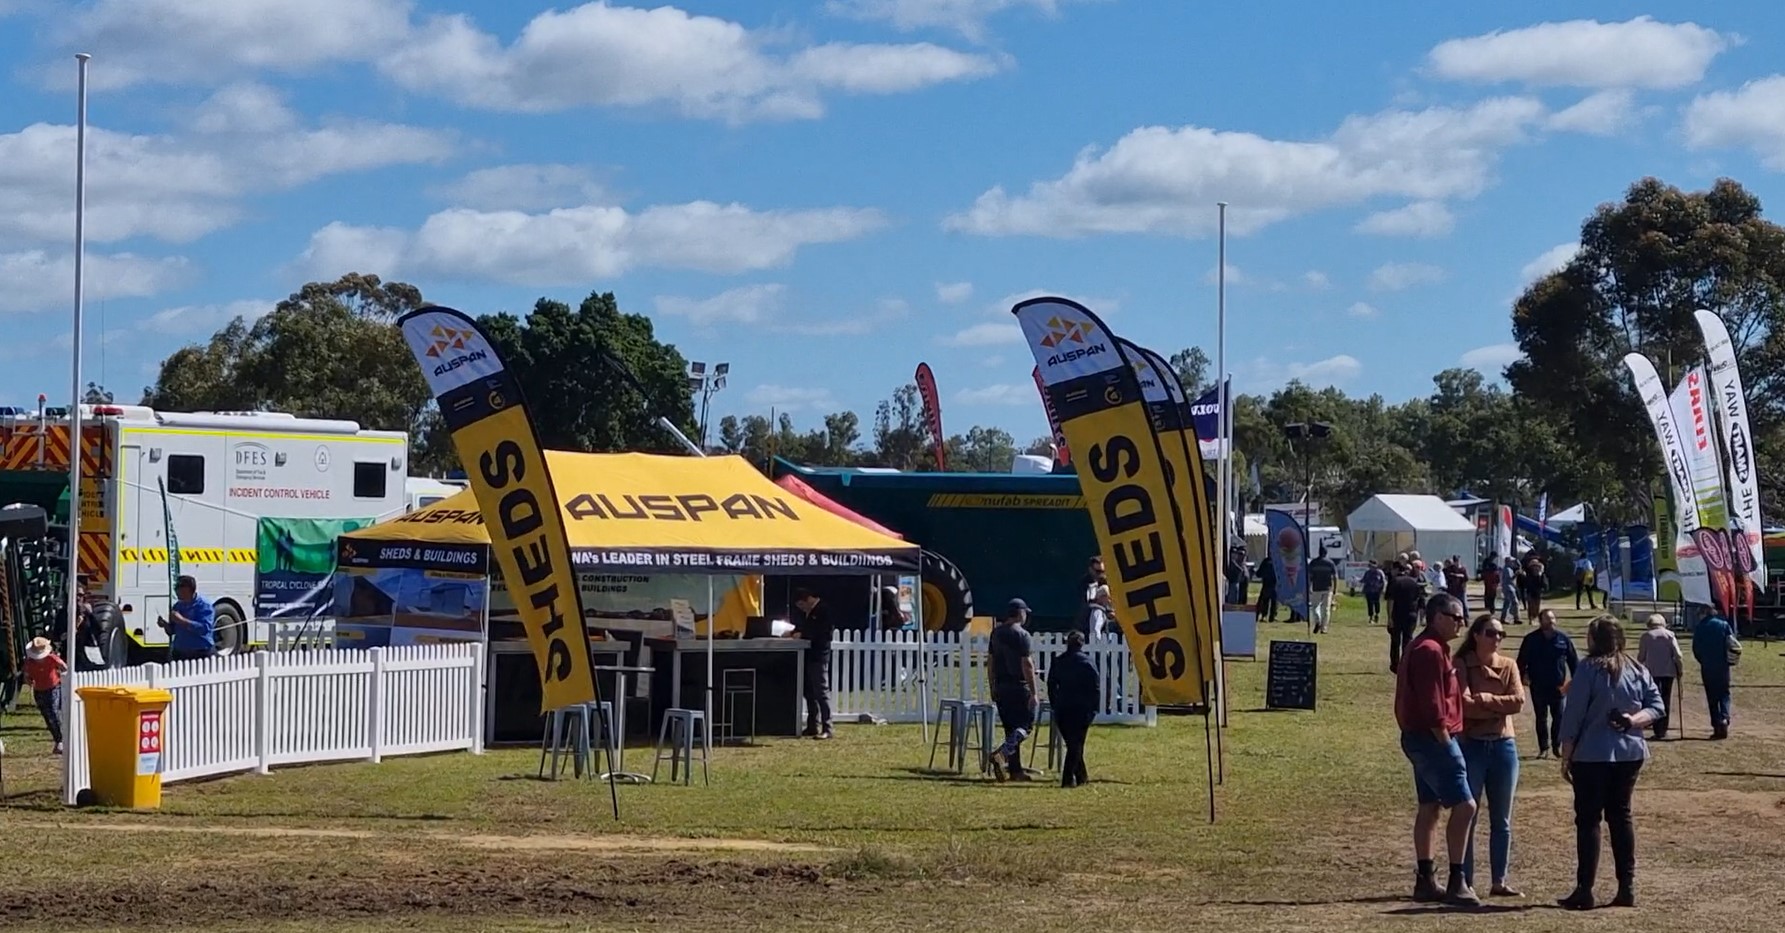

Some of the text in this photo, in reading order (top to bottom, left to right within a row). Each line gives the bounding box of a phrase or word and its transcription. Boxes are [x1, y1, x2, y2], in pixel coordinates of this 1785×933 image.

[433, 349, 487, 377] AUSPAN
[1047, 344, 1106, 367] AUSPAN
[235, 451, 267, 465] DFES
[229, 488, 330, 499] INCIDENT CONTROL VEHICLE
[564, 493, 800, 521] AUSPAN
[379, 547, 412, 560] SHEDS
[413, 548, 421, 560] &
[423, 549, 478, 564] BUILDINGS
[479, 440, 572, 683] SHEDS
[601, 552, 653, 565] LEADER
[655, 553, 670, 566] IN
[672, 553, 714, 566] STEEL
[715, 554, 760, 567] FRAME
[763, 554, 805, 566] SHEDS
[808, 553, 818, 566] &
[1088, 435, 1186, 681] SHEDS
[261, 580, 288, 589] TROPICAL
[582, 574, 650, 583] CONSTRUCTION
[581, 585, 628, 593] BUILDINGS
